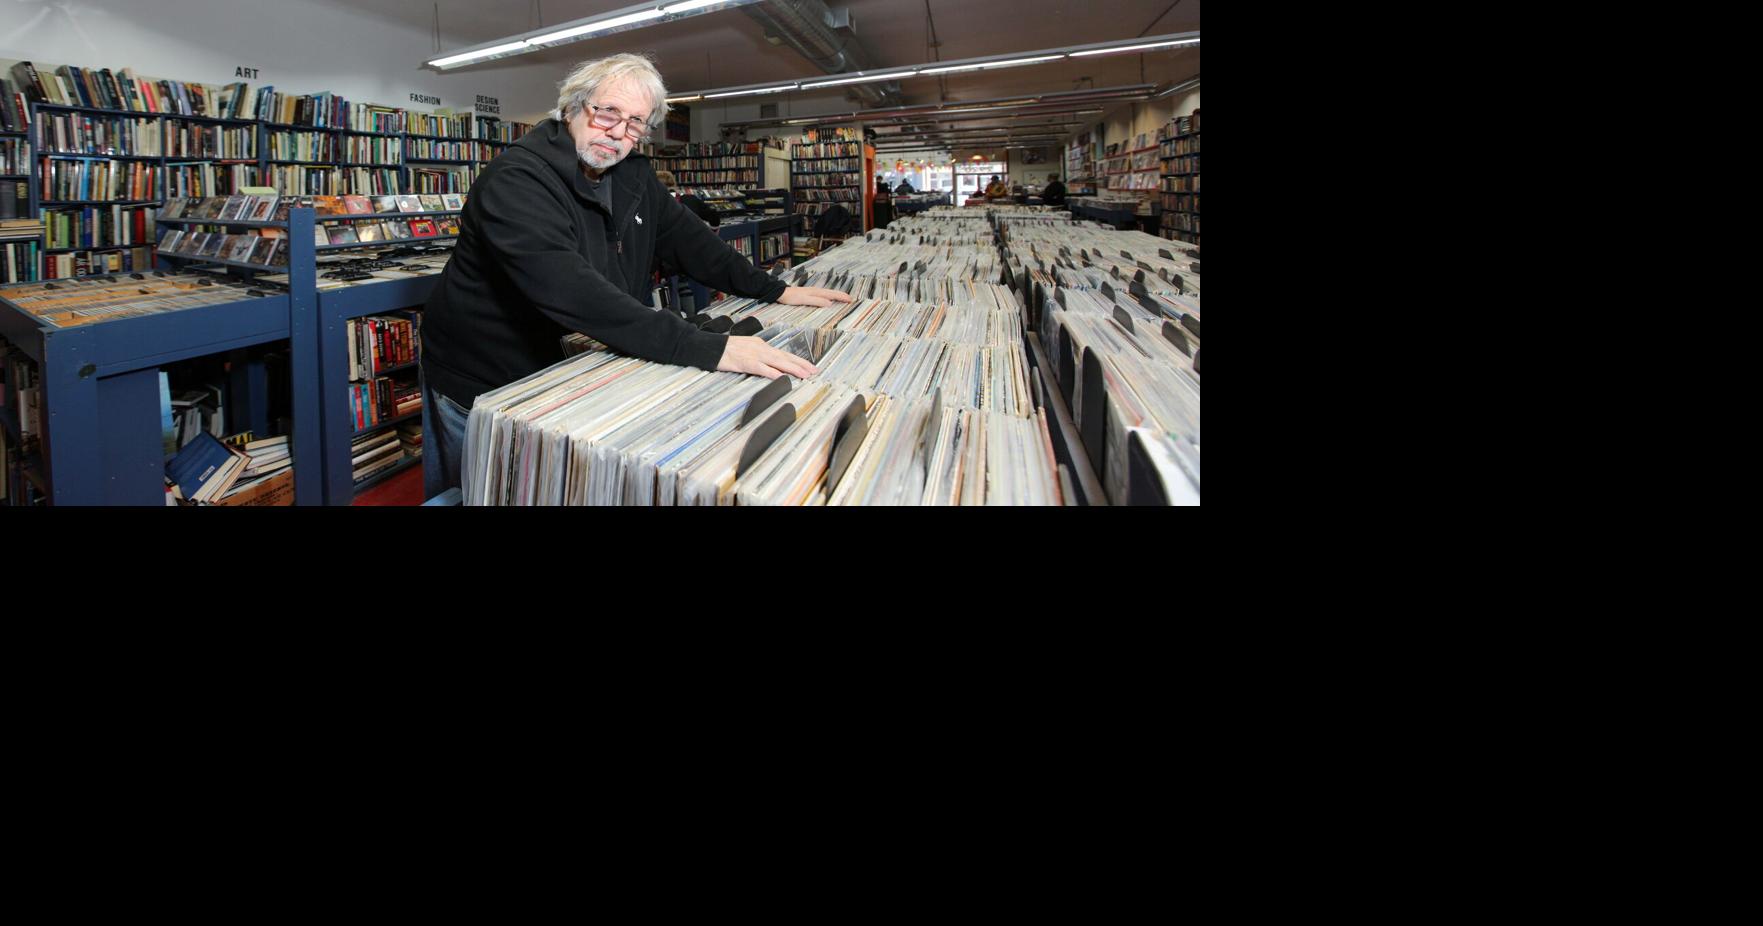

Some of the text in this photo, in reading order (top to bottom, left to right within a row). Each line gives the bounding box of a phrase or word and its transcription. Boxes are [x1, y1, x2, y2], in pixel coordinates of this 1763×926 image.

[235, 66, 259, 79] ART
[410, 93, 441, 106] FASHION
[476, 94, 499, 105] DESIGN
[475, 103, 501, 114] SCIENCE
